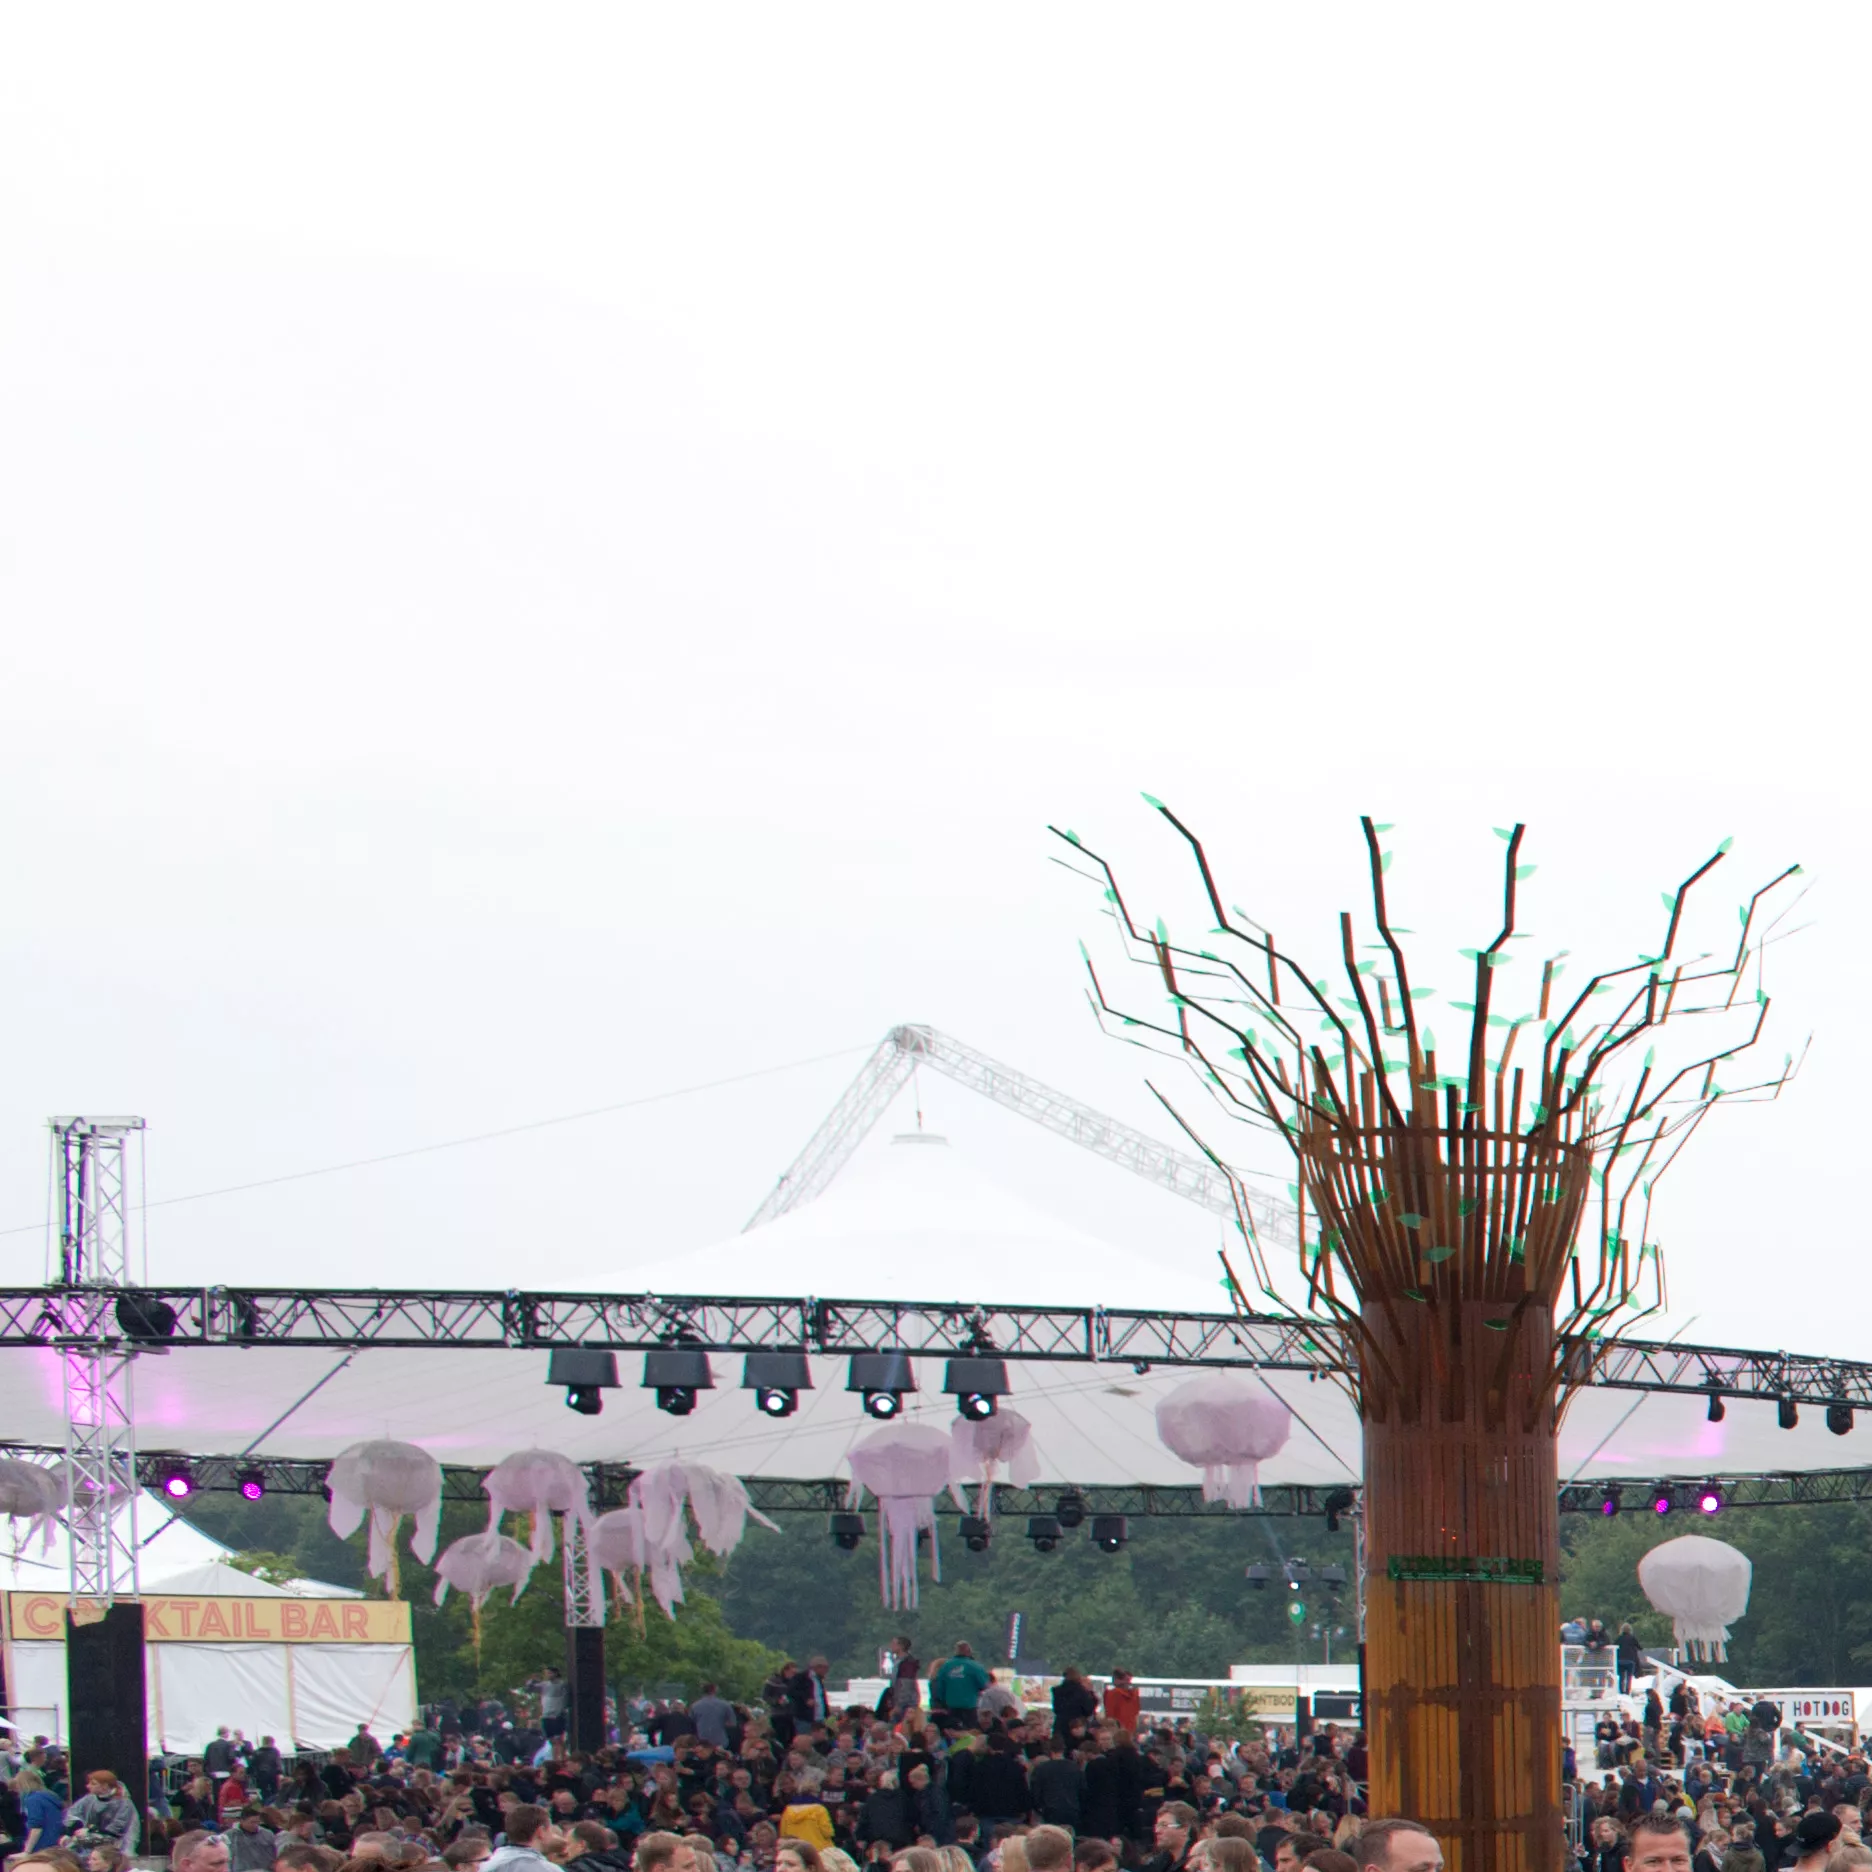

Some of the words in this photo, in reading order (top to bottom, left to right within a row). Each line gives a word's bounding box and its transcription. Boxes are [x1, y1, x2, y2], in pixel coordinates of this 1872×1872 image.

[24, 1596, 270, 1638] CKTAIL
[281, 1603, 369, 1639] BAR
[1793, 1700, 1849, 1716] HOTDOG
